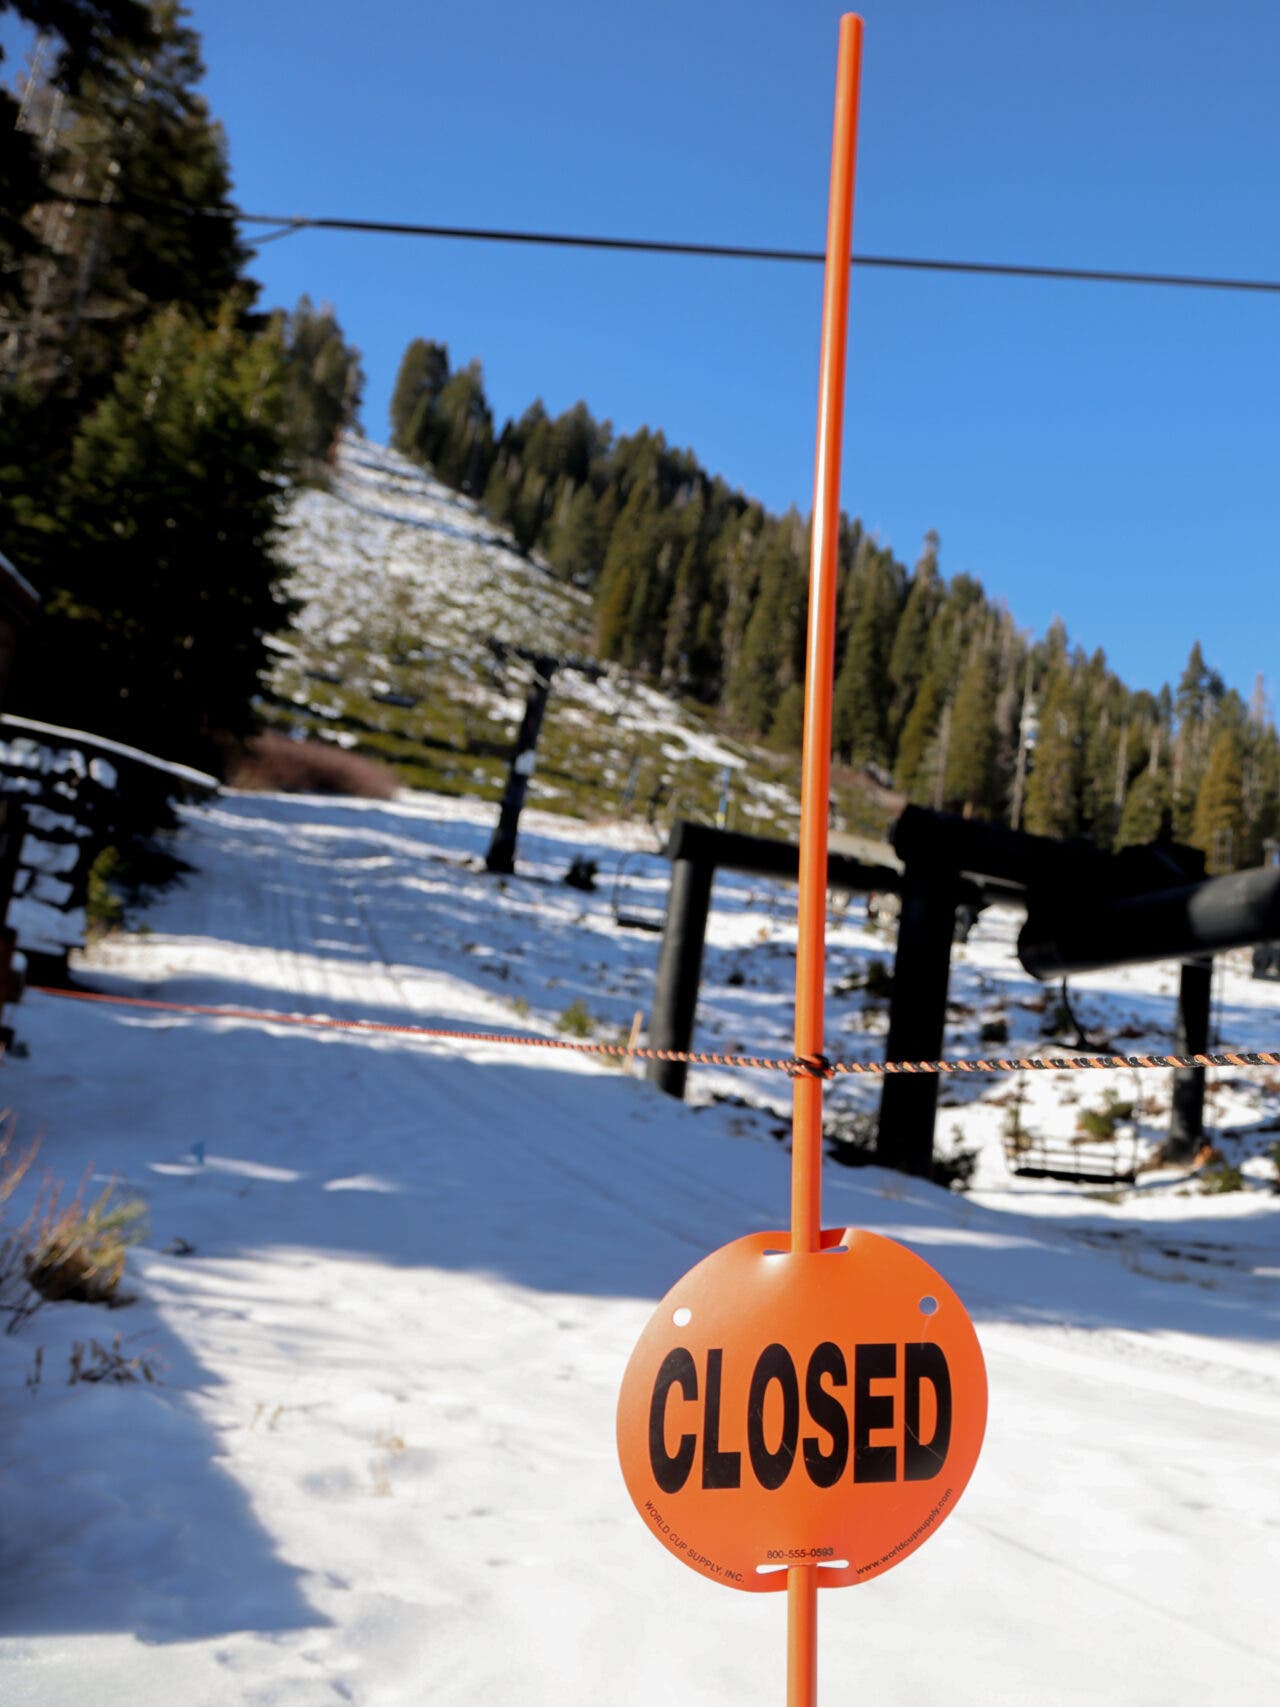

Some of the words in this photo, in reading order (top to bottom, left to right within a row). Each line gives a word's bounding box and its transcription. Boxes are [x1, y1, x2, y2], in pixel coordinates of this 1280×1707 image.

[649, 1341, 952, 1494] CLOSED
[644, 1499, 670, 1534] WORLD
[669, 1533, 688, 1552] CUP
[687, 1549, 722, 1575] SUPPLY,
[724, 1570, 745, 1583] INC.
[856, 1488, 953, 1575] www.worldcupsupply.com
